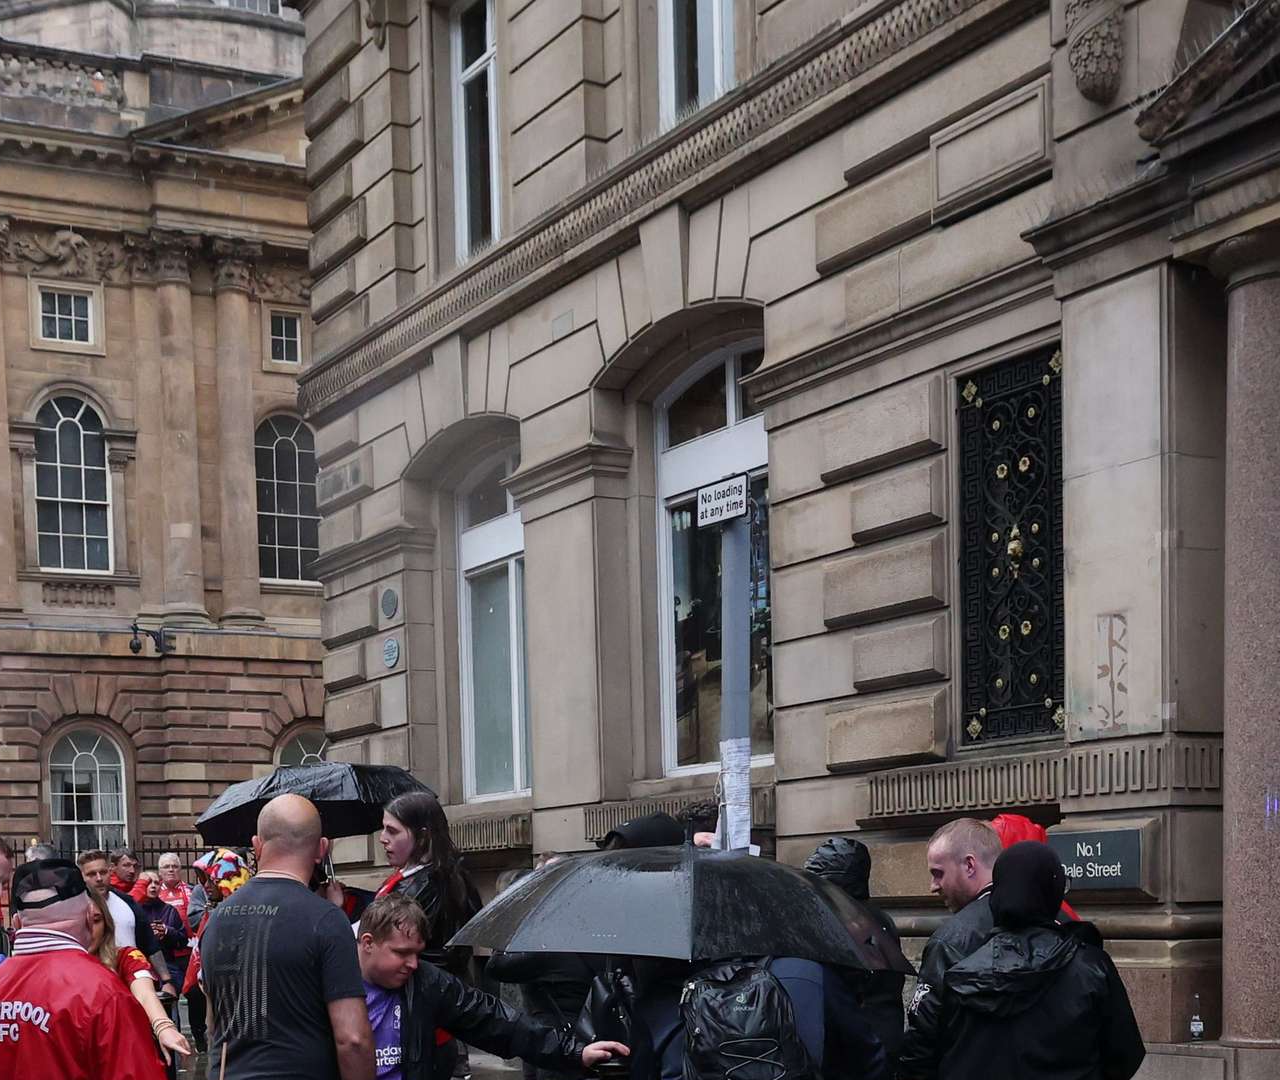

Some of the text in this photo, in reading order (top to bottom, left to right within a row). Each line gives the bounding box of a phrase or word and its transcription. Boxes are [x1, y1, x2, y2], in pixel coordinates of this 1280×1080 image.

[701, 484, 743, 504] No loading
[700, 500, 744, 520] at any time
[1086, 861, 1122, 878] Street
[218, 904, 280, 917] FREEDOM
